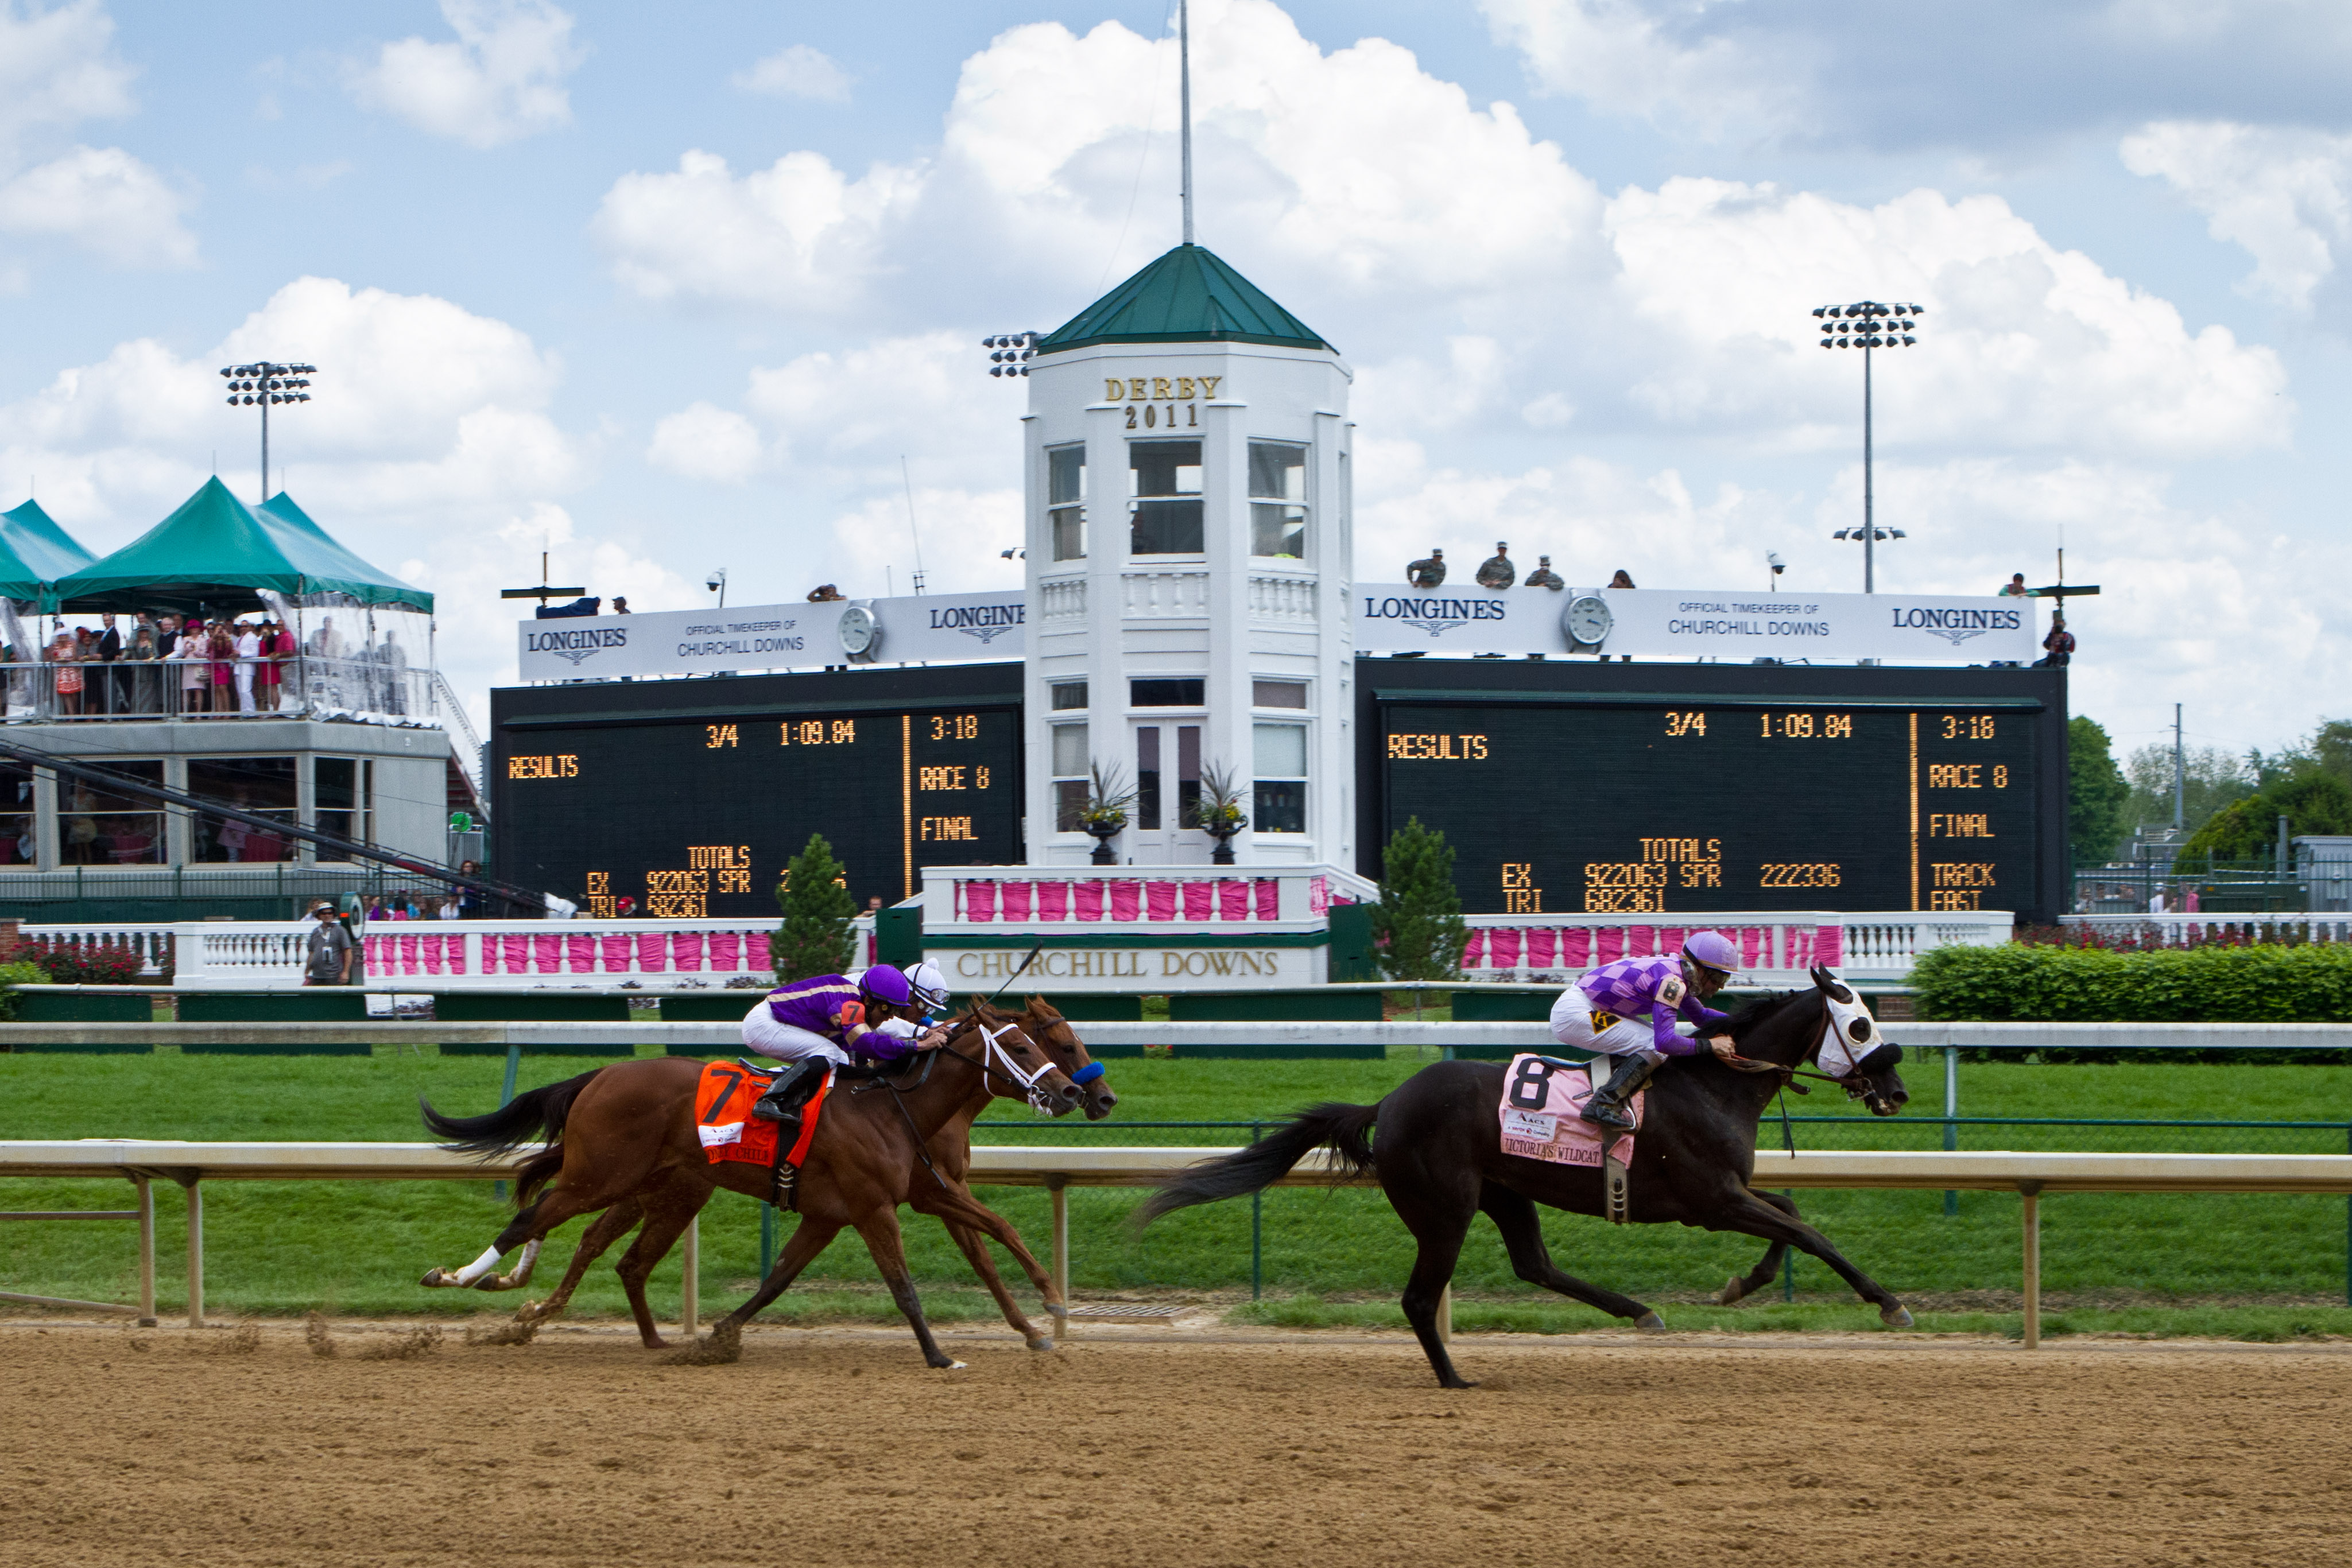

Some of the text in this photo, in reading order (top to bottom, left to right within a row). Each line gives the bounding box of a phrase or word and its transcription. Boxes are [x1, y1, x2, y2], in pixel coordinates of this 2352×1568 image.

[1105, 377, 1222, 401] DERBY
[1125, 403, 1198, 429] 2011
[929, 604, 1025, 628] LONGINE
[1365, 597, 1505, 620] LONGINES
[1679, 602, 1820, 615] OFFICIAL TIMEKEEPER OF
[1892, 608, 2021, 630] LONGINES
[528, 627, 626, 651] LONGINES
[685, 620, 797, 636] OFFICIAL TIMEKEEPER OF
[1668, 619, 1830, 636] CHURCHILL DOWNS
[677, 636, 804, 657] CHURCHILL DOWNS
[706, 720, 855, 748] 3/4 1:09.84
[931, 715, 978, 740] 3:18
[1665, 712, 1853, 738] 3/4 1:09.84
[1942, 715, 1995, 739] 3:18
[1388, 734, 1488, 759] RESULTS
[509, 754, 579, 779] RESULTS
[920, 766, 990, 791] RACE 8
[1929, 764, 2008, 788] RACE 8
[921, 816, 979, 841] FINAL
[1930, 814, 1995, 837] FINAL
[687, 845, 750, 869] TOTALS
[1640, 838, 1722, 862] TOTALS
[587, 870, 751, 895] EX 922063 SPR
[1502, 863, 1841, 888] EX 922063 SPR 222336
[1931, 863, 1996, 887] TRACK
[588, 895, 617, 918] TRI
[1502, 888, 1665, 913] TRI 682361
[1931, 890, 1982, 911] FAST
[957, 951, 1278, 976] CHURCHILL DOWNS
[1663, 981, 1680, 1002] 8
[848, 1006, 859, 1022] 7
[703, 1069, 743, 1123] 7
[1509, 1058, 1555, 1111] 8
[1558, 1147, 1600, 1163] WILDCAT
